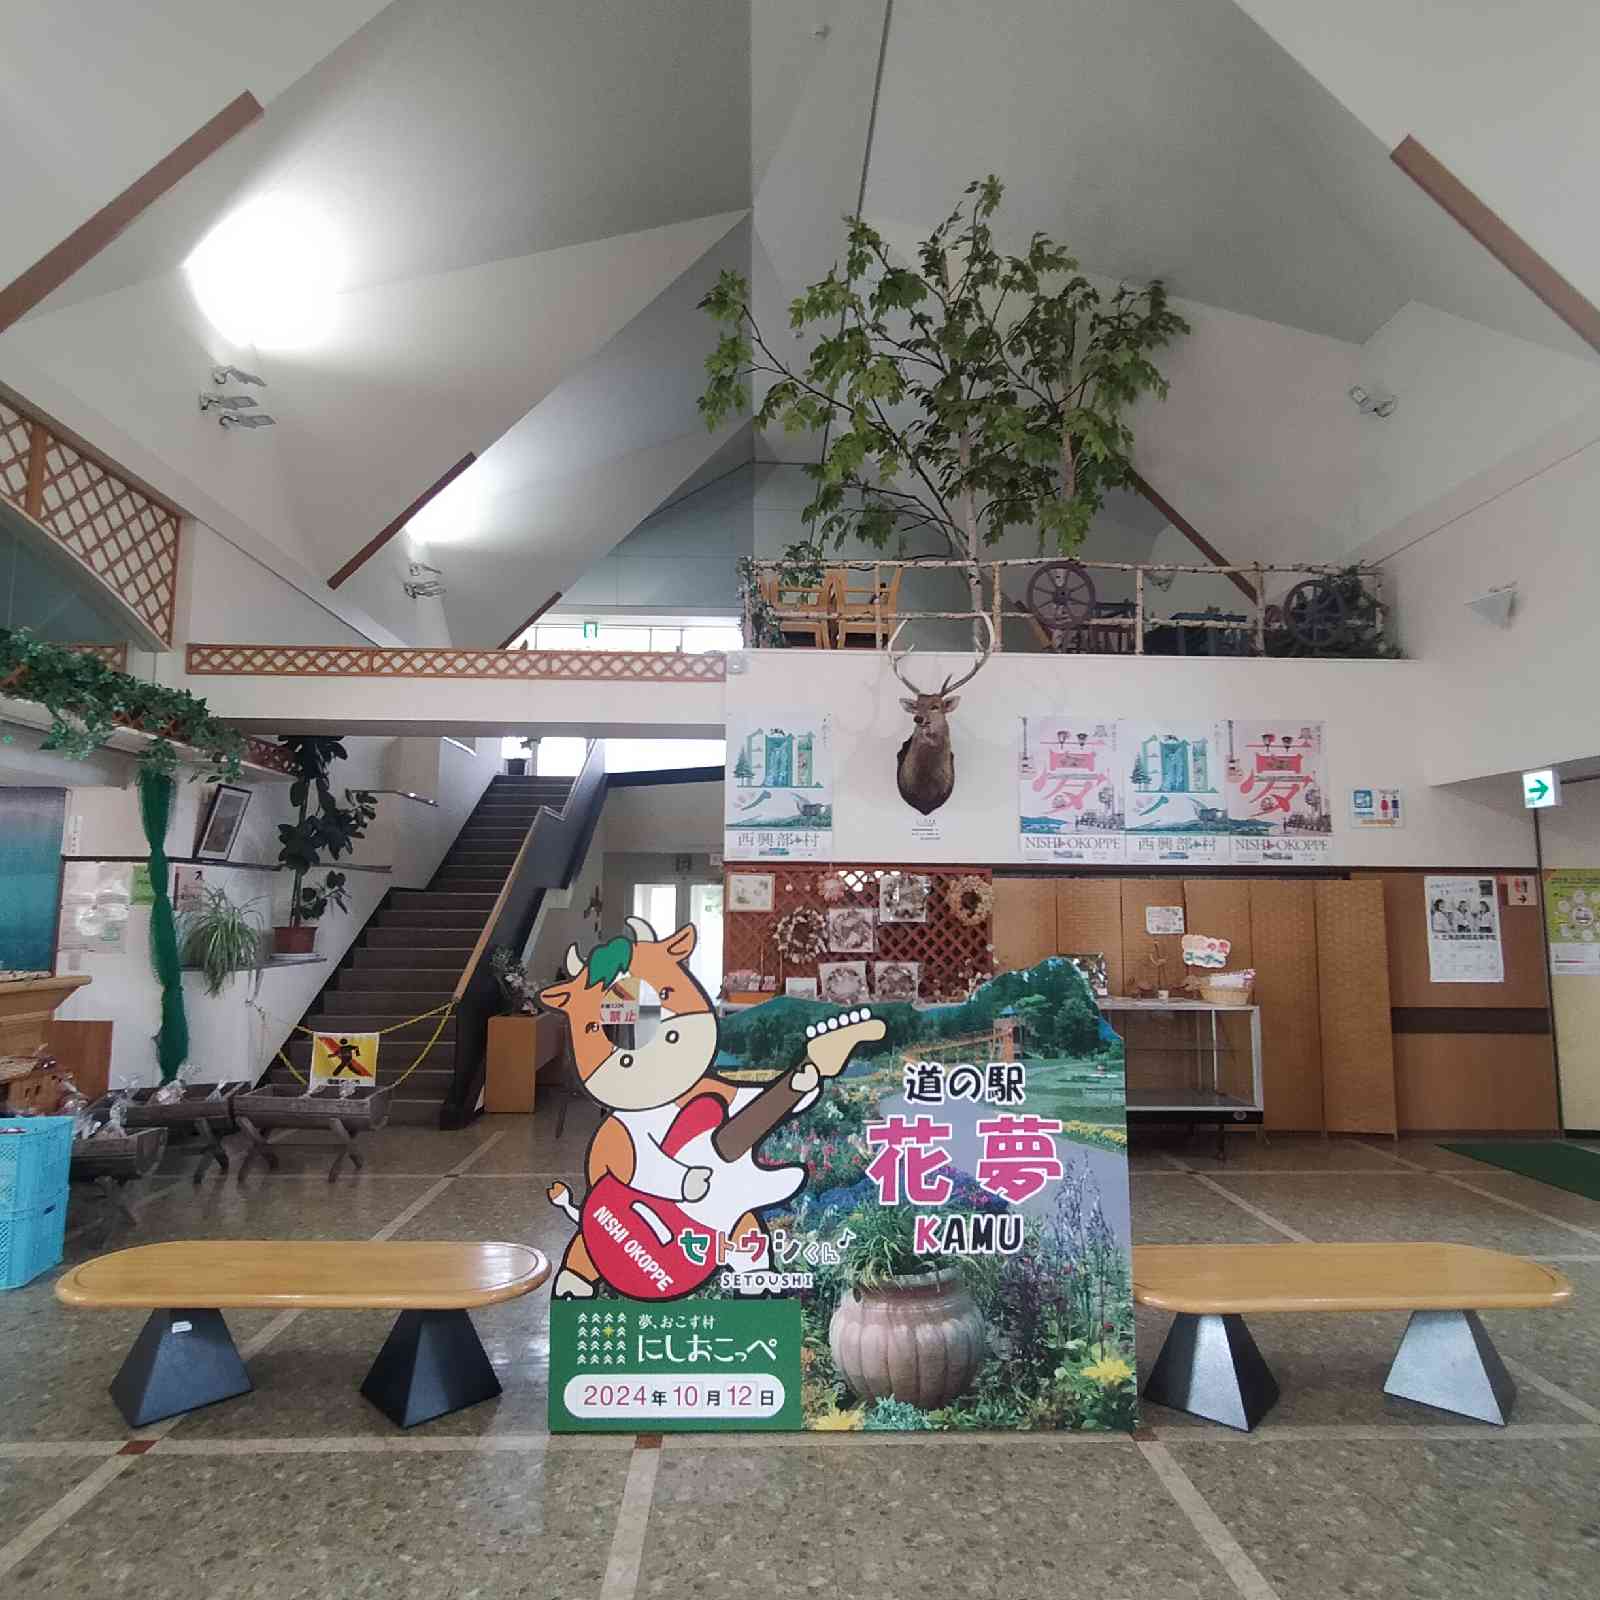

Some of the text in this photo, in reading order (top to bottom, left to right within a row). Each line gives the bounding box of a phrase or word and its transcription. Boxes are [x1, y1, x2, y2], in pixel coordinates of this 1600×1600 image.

[905, 1063, 1025, 1103] 道の駅
[868, 1115, 1062, 1205] 花夢
[593, 1206, 674, 1292] NISHI OKOPPE
[915, 1215, 1024, 1253] KAMU
[721, 1272, 813, 1288] SETOUSHI
[637, 1333, 777, 1362] にしおこっぺ
